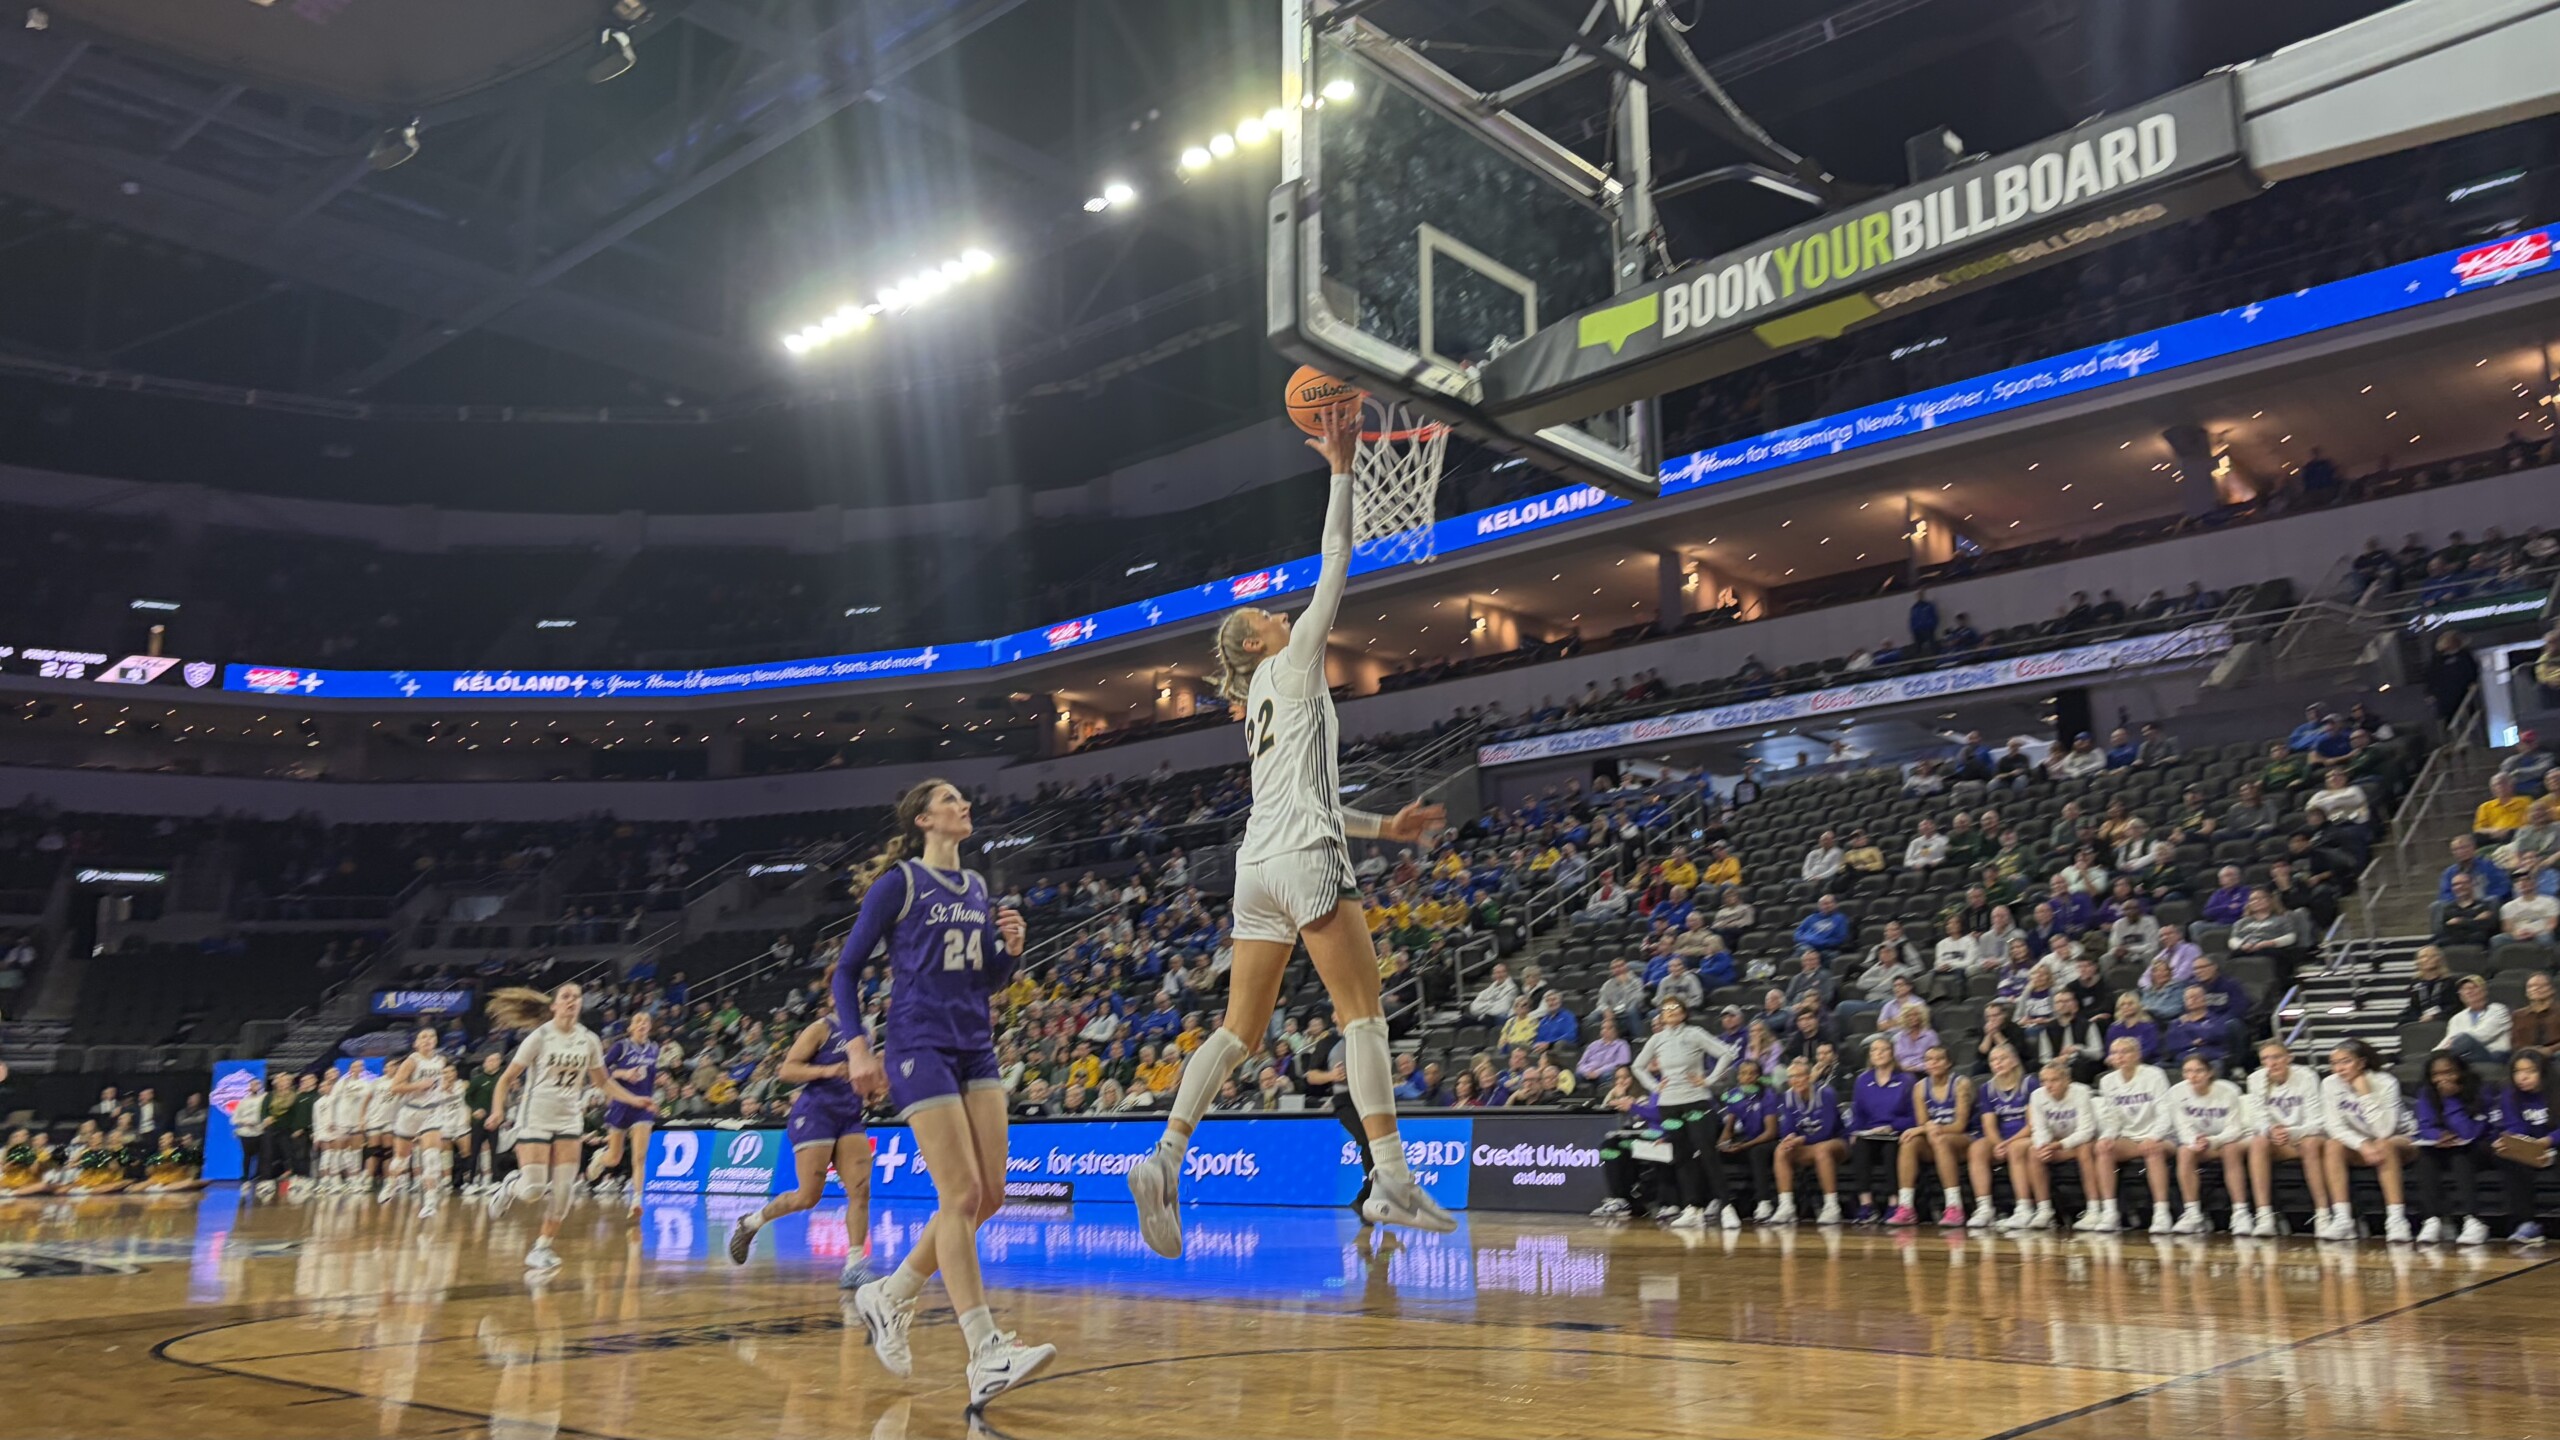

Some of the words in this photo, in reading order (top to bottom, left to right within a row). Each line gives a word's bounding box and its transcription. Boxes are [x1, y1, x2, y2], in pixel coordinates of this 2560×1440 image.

[1301, 383, 1352, 403] Wilson
[1771, 424, 1853, 458] streaming
[2059, 355, 2098, 383] and
[40, 661, 85, 679] 2/2
[943, 928, 983, 971] 24
[555, 1069, 579, 1087] 12
[1006, 1154, 1041, 1173] ome
[1046, 1146, 1075, 1175] for
[1073, 1149, 1153, 1175] streami
[1472, 1143, 1536, 1167] Credit
